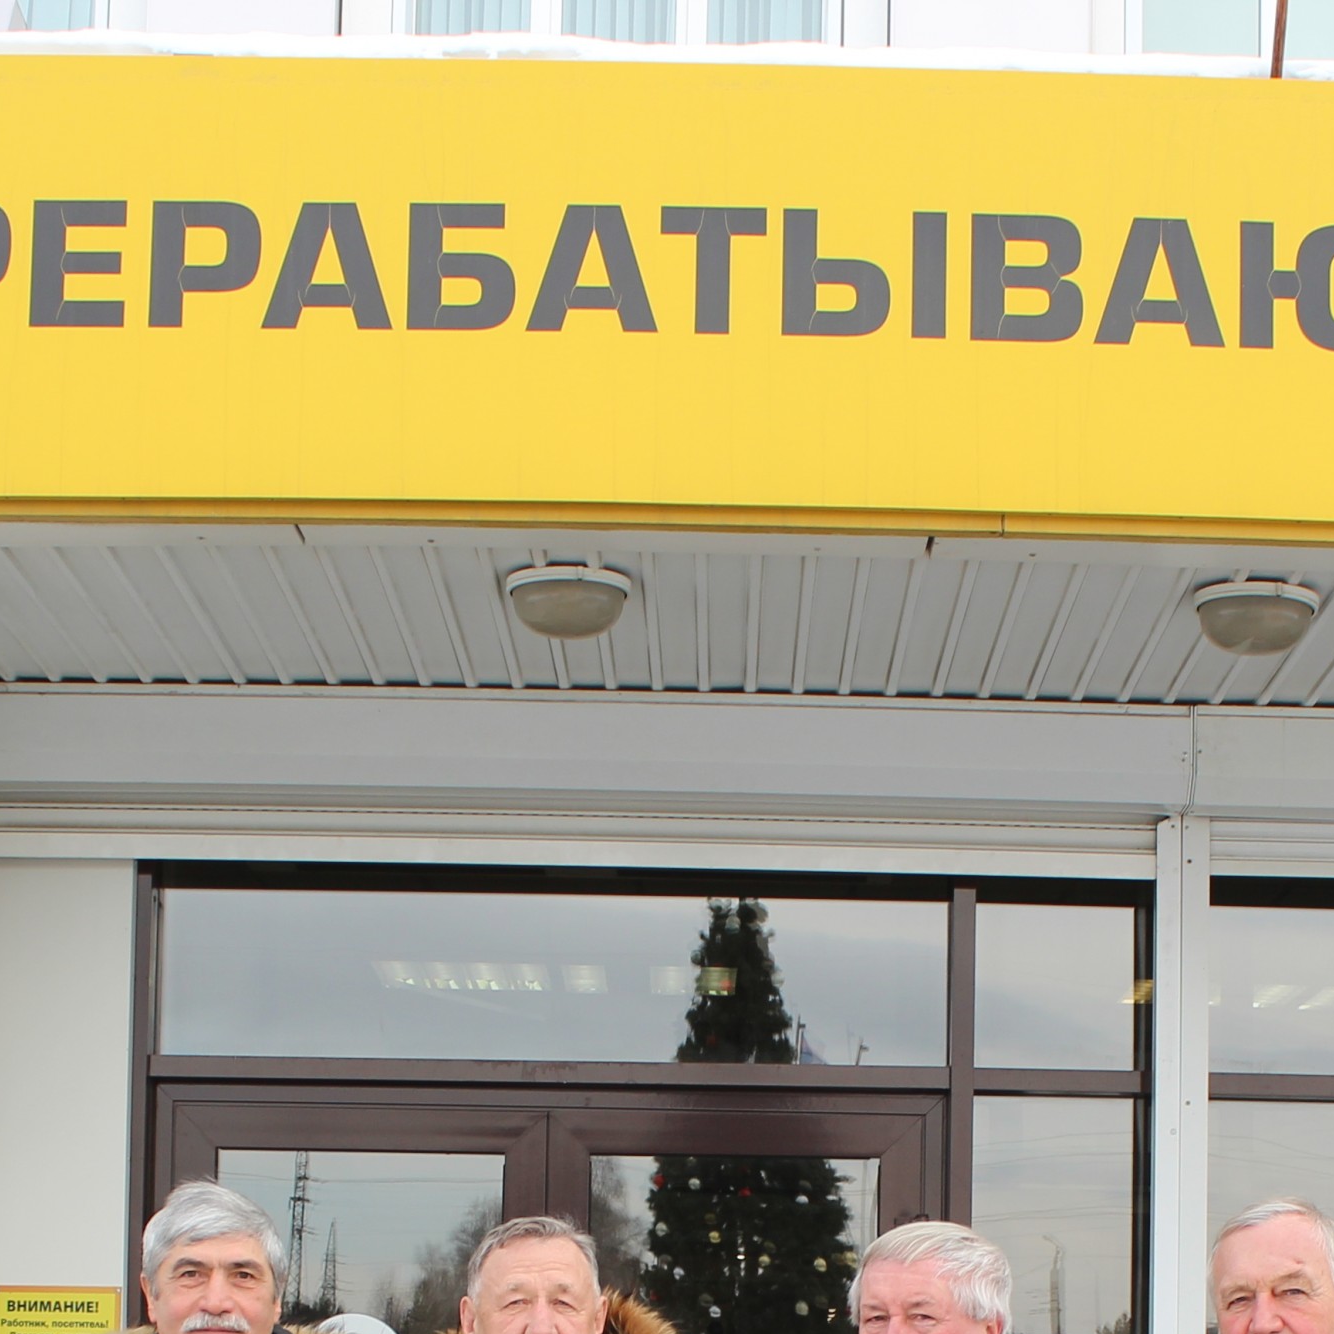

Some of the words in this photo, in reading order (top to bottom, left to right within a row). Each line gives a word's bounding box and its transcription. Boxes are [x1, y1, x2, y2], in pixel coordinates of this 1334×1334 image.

[6, 1299, 100, 1314] ВНИМАНИЕ!
[0, 1318, 50, 1329] Работник,
[51, 1320, 110, 1329] посетитель!
